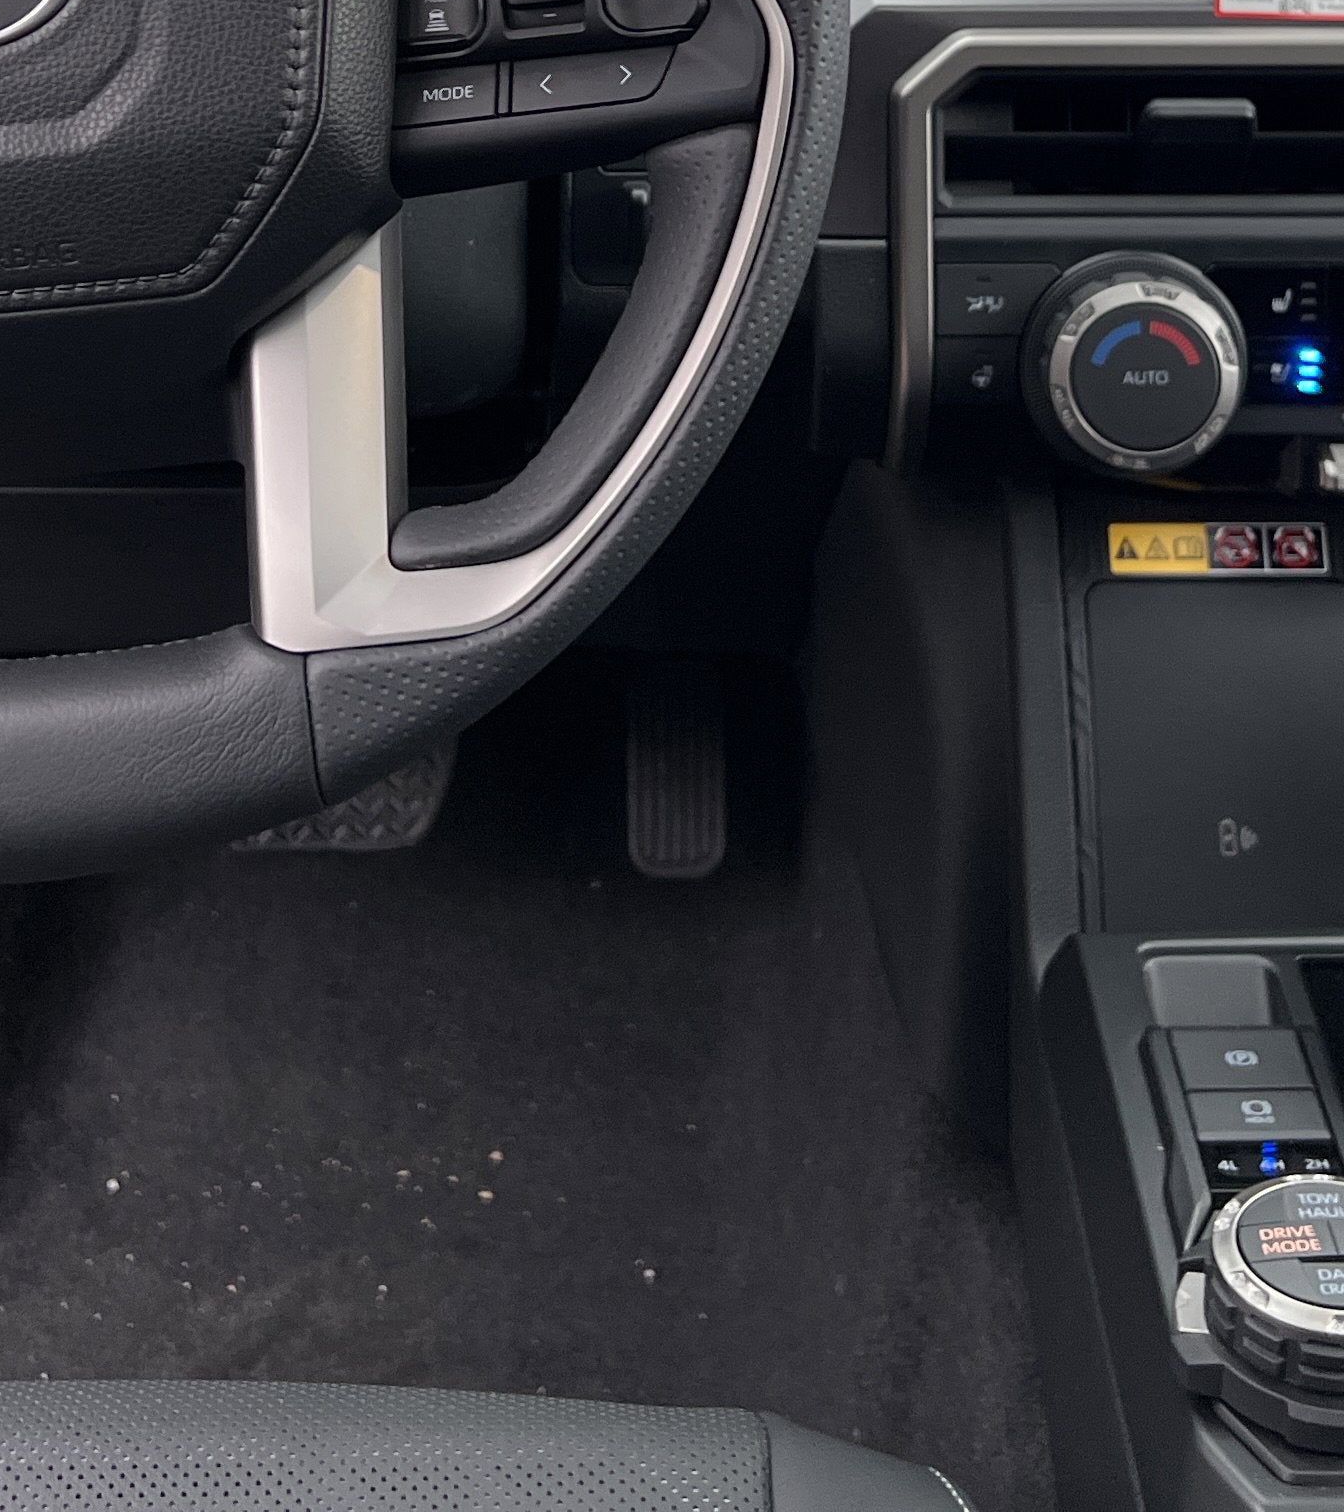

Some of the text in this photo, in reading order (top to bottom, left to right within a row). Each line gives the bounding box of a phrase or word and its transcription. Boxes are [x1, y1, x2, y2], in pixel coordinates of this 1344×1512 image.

[422, 85, 474, 102] MODE
[1122, 370, 1169, 386] AUTO
[1217, 1159, 1238, 1171] 4L
[1305, 1158, 1330, 1170] 2H
[1296, 1192, 1339, 1205] TOW
[1259, 1225, 1317, 1241] DRIVE
[1262, 1238, 1322, 1255] MODE
